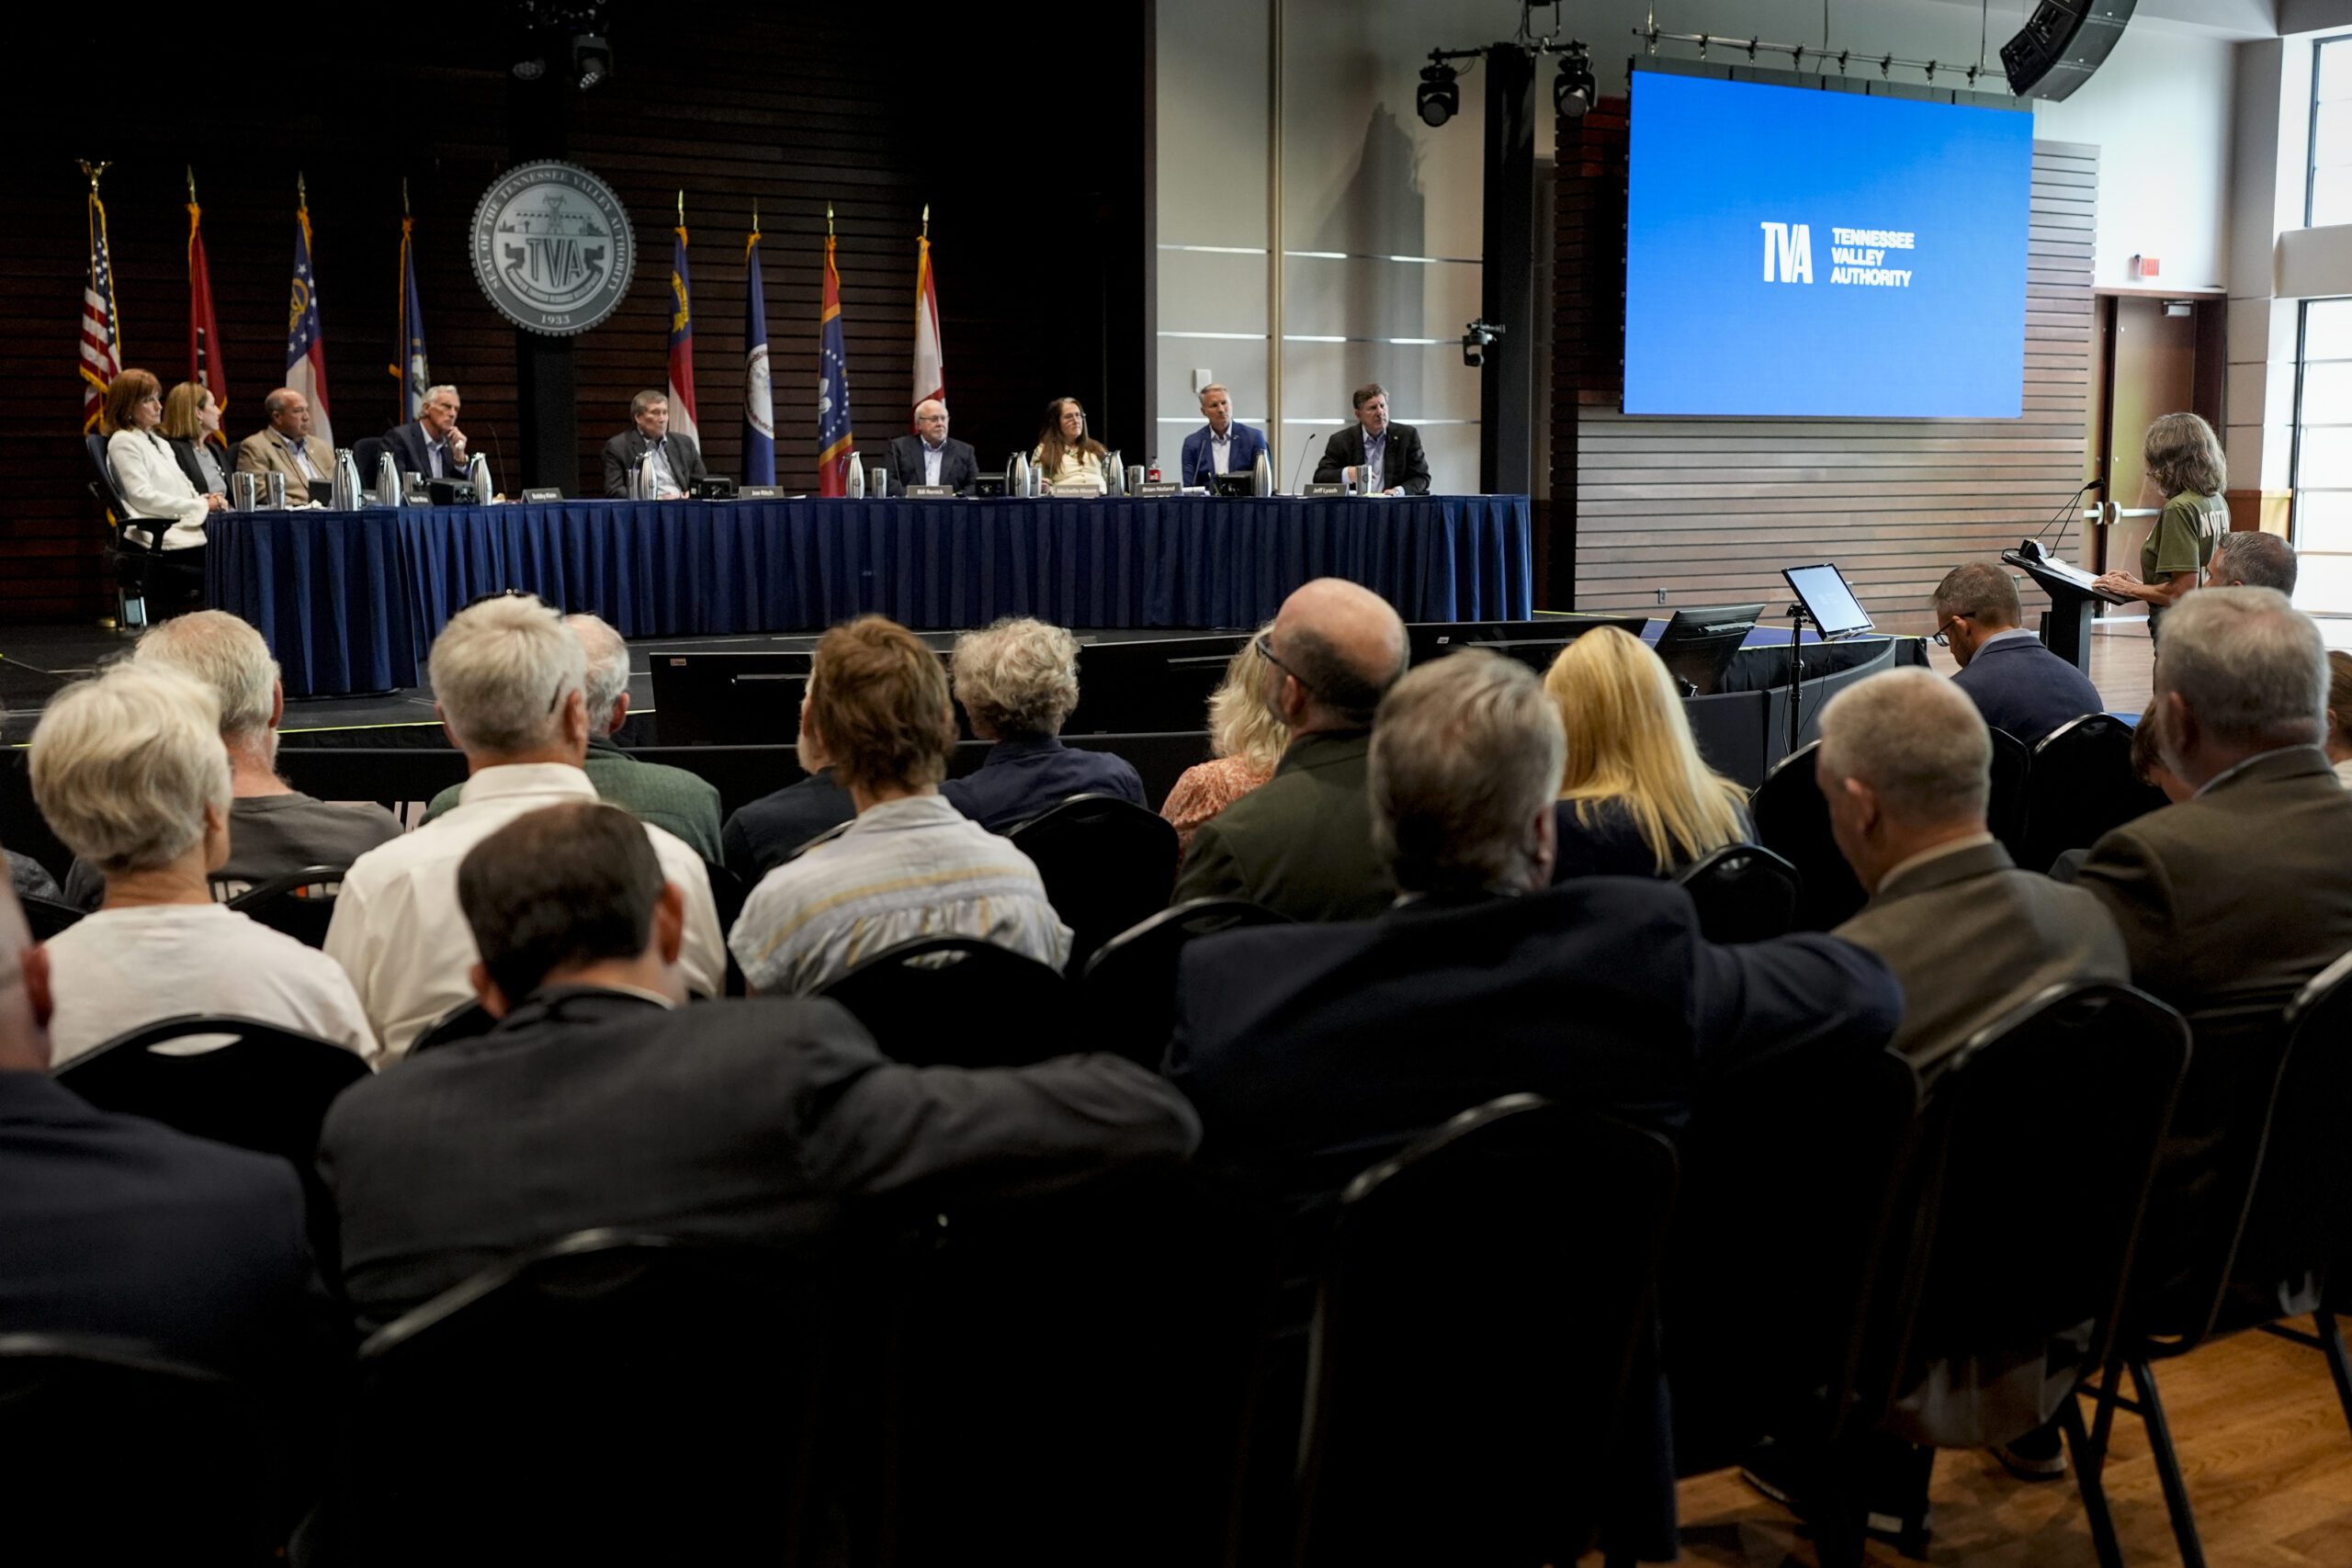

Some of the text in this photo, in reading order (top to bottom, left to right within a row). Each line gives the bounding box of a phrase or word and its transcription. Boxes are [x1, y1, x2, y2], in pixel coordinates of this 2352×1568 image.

[500, 171, 569, 198] TENNESSEE
[573, 176, 611, 211] VALLEY
[482, 198, 501, 226] THE
[481, 231, 491, 251] OF
[1760, 221, 1814, 284] TVA
[1832, 228, 1916, 250] TENNESSEE
[526, 238, 584, 288] TVA
[607, 217, 626, 291] AUTHORITY
[1831, 247, 1885, 266] VALLEY
[481, 254, 500, 289] SEAL
[1830, 266, 1912, 288] AUTHORITY
[541, 314, 571, 324] 1933
